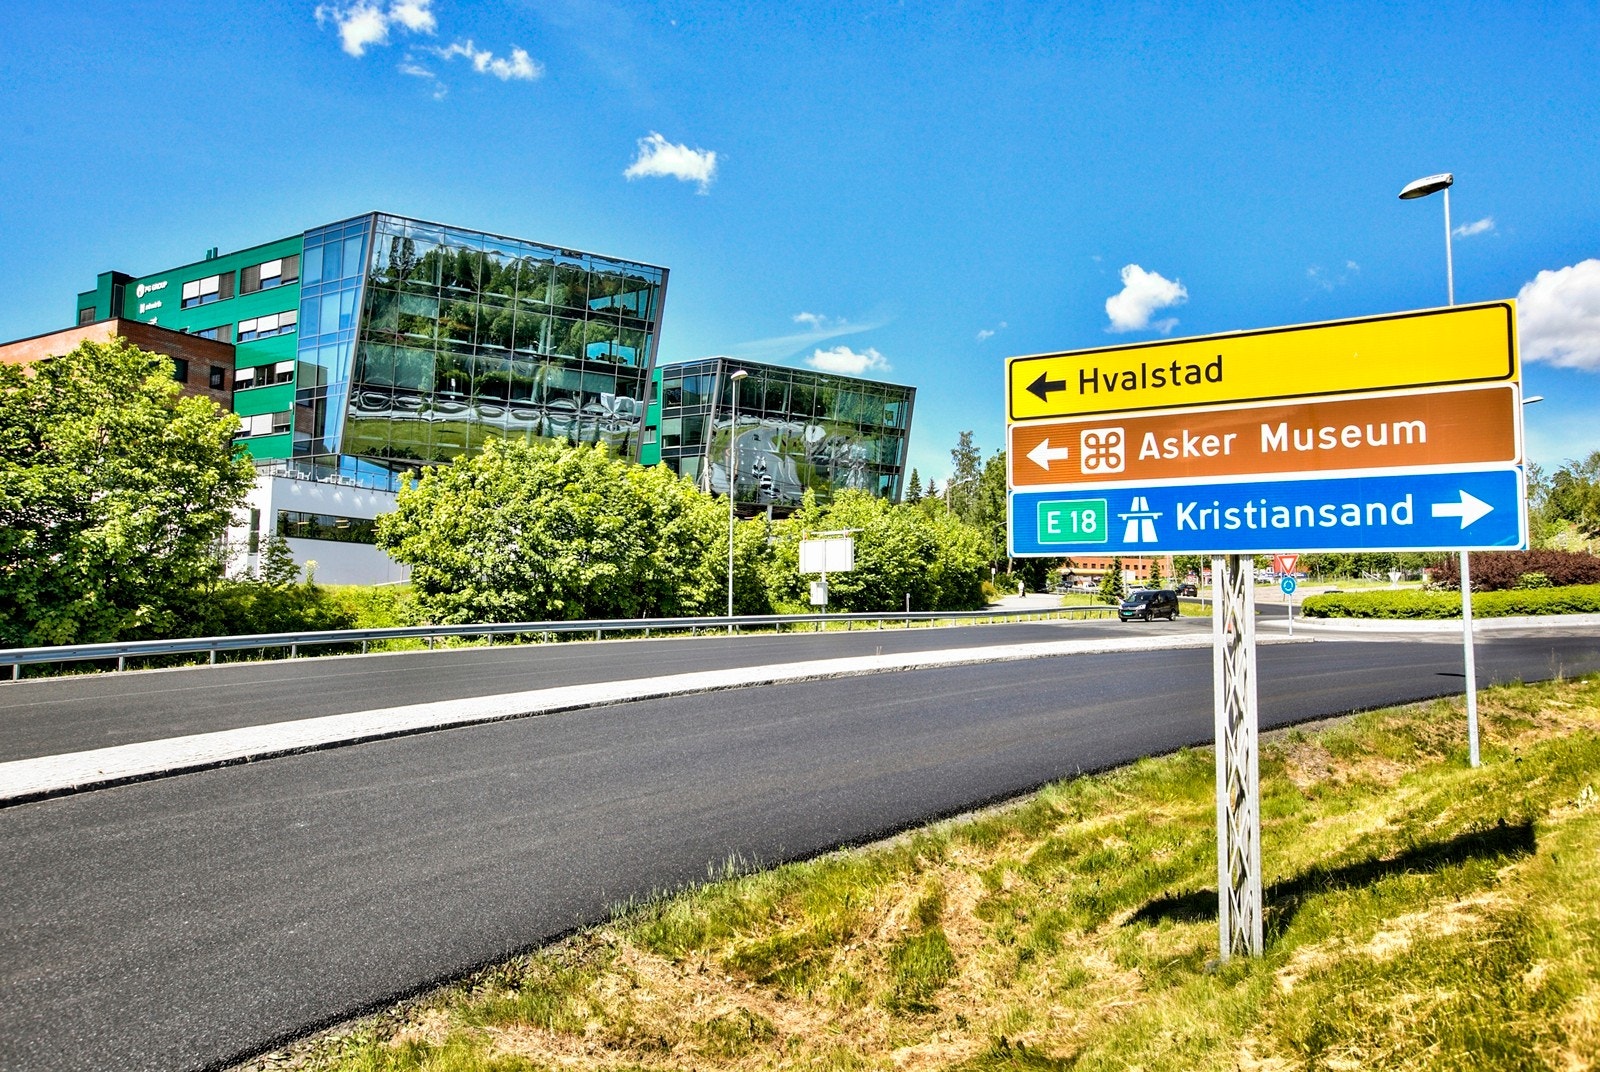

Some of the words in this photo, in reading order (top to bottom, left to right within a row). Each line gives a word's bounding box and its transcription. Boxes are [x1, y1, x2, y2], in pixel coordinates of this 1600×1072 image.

[1079, 355, 1223, 394] Hvalstad
[1138, 430, 1237, 461] Asker
[1261, 420, 1427, 453] Museum
[1047, 511, 1061, 534] E
[1070, 510, 1097, 533] 18
[1176, 494, 1413, 531] Kristiansand
